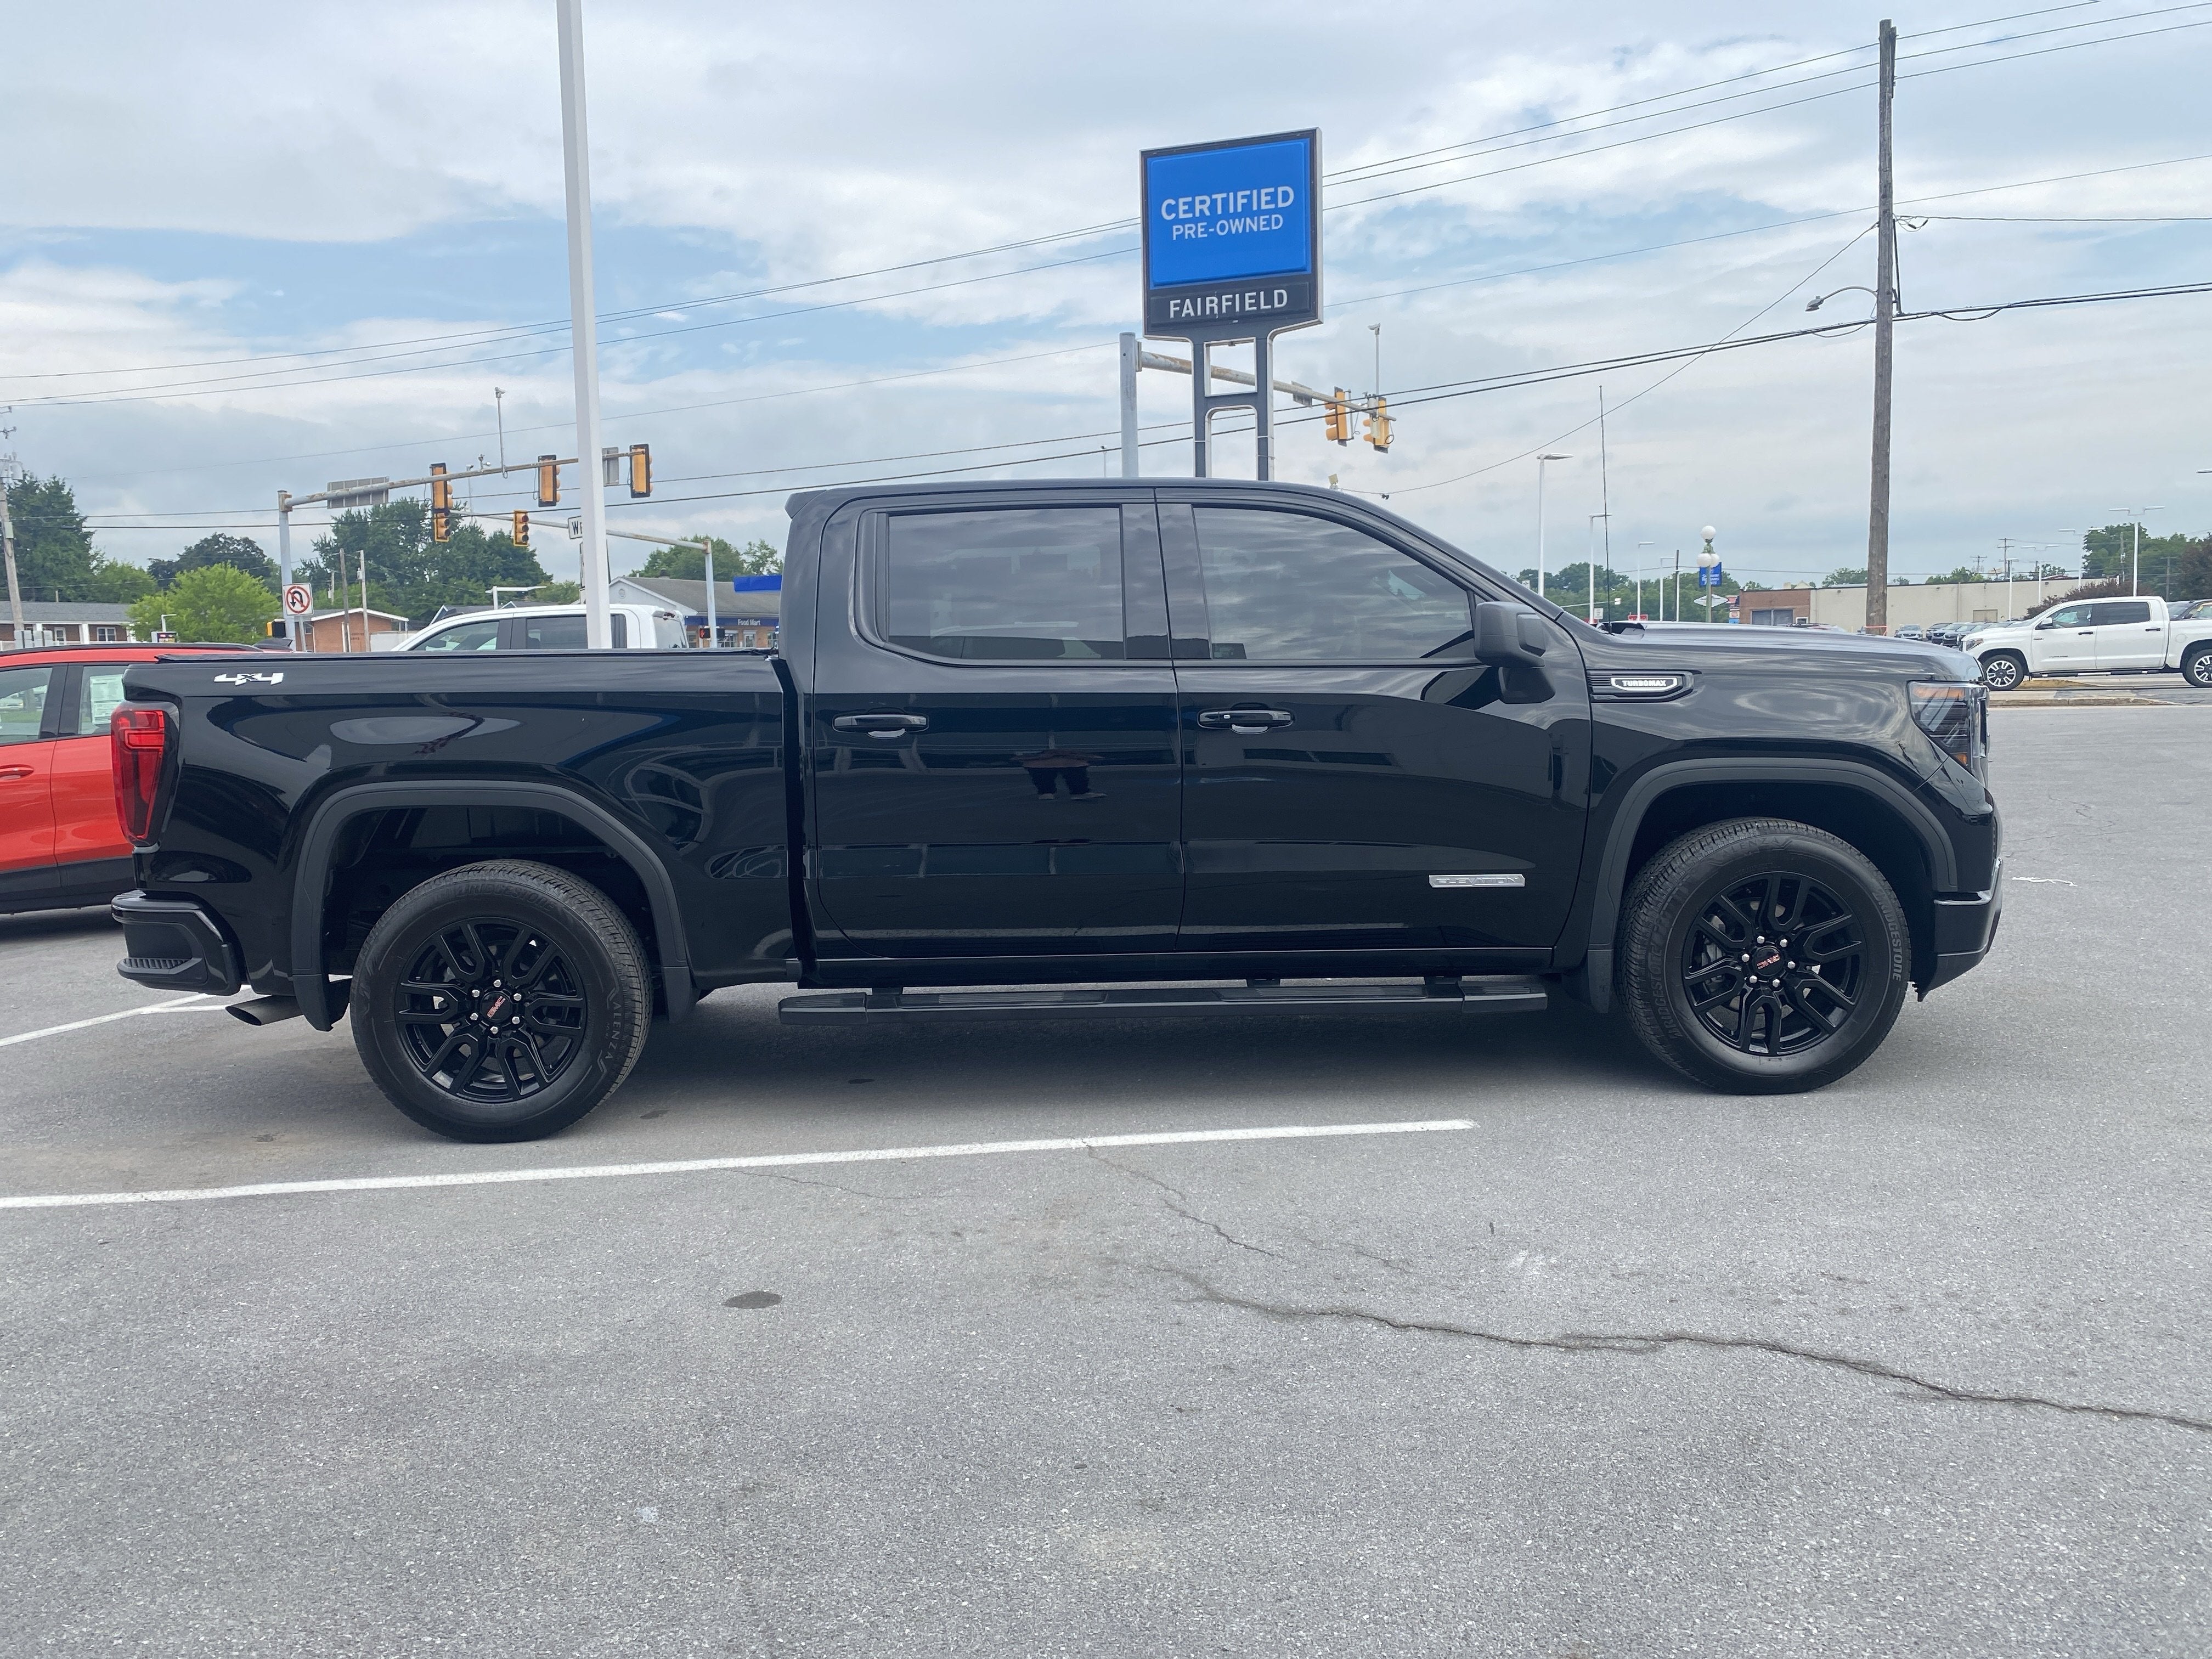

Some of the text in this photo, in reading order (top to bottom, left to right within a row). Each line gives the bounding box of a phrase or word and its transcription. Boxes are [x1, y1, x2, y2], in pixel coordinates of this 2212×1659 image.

[1161, 185, 1295, 221] CERTIFIED
[1172, 214, 1284, 240] PRE-OWNED
[1169, 289, 1288, 319] FAIRFIELD
[1757, 954, 1780, 969] GMC
[487, 996, 506, 1018] GMC
[605, 1002, 622, 1059] ALENZA
